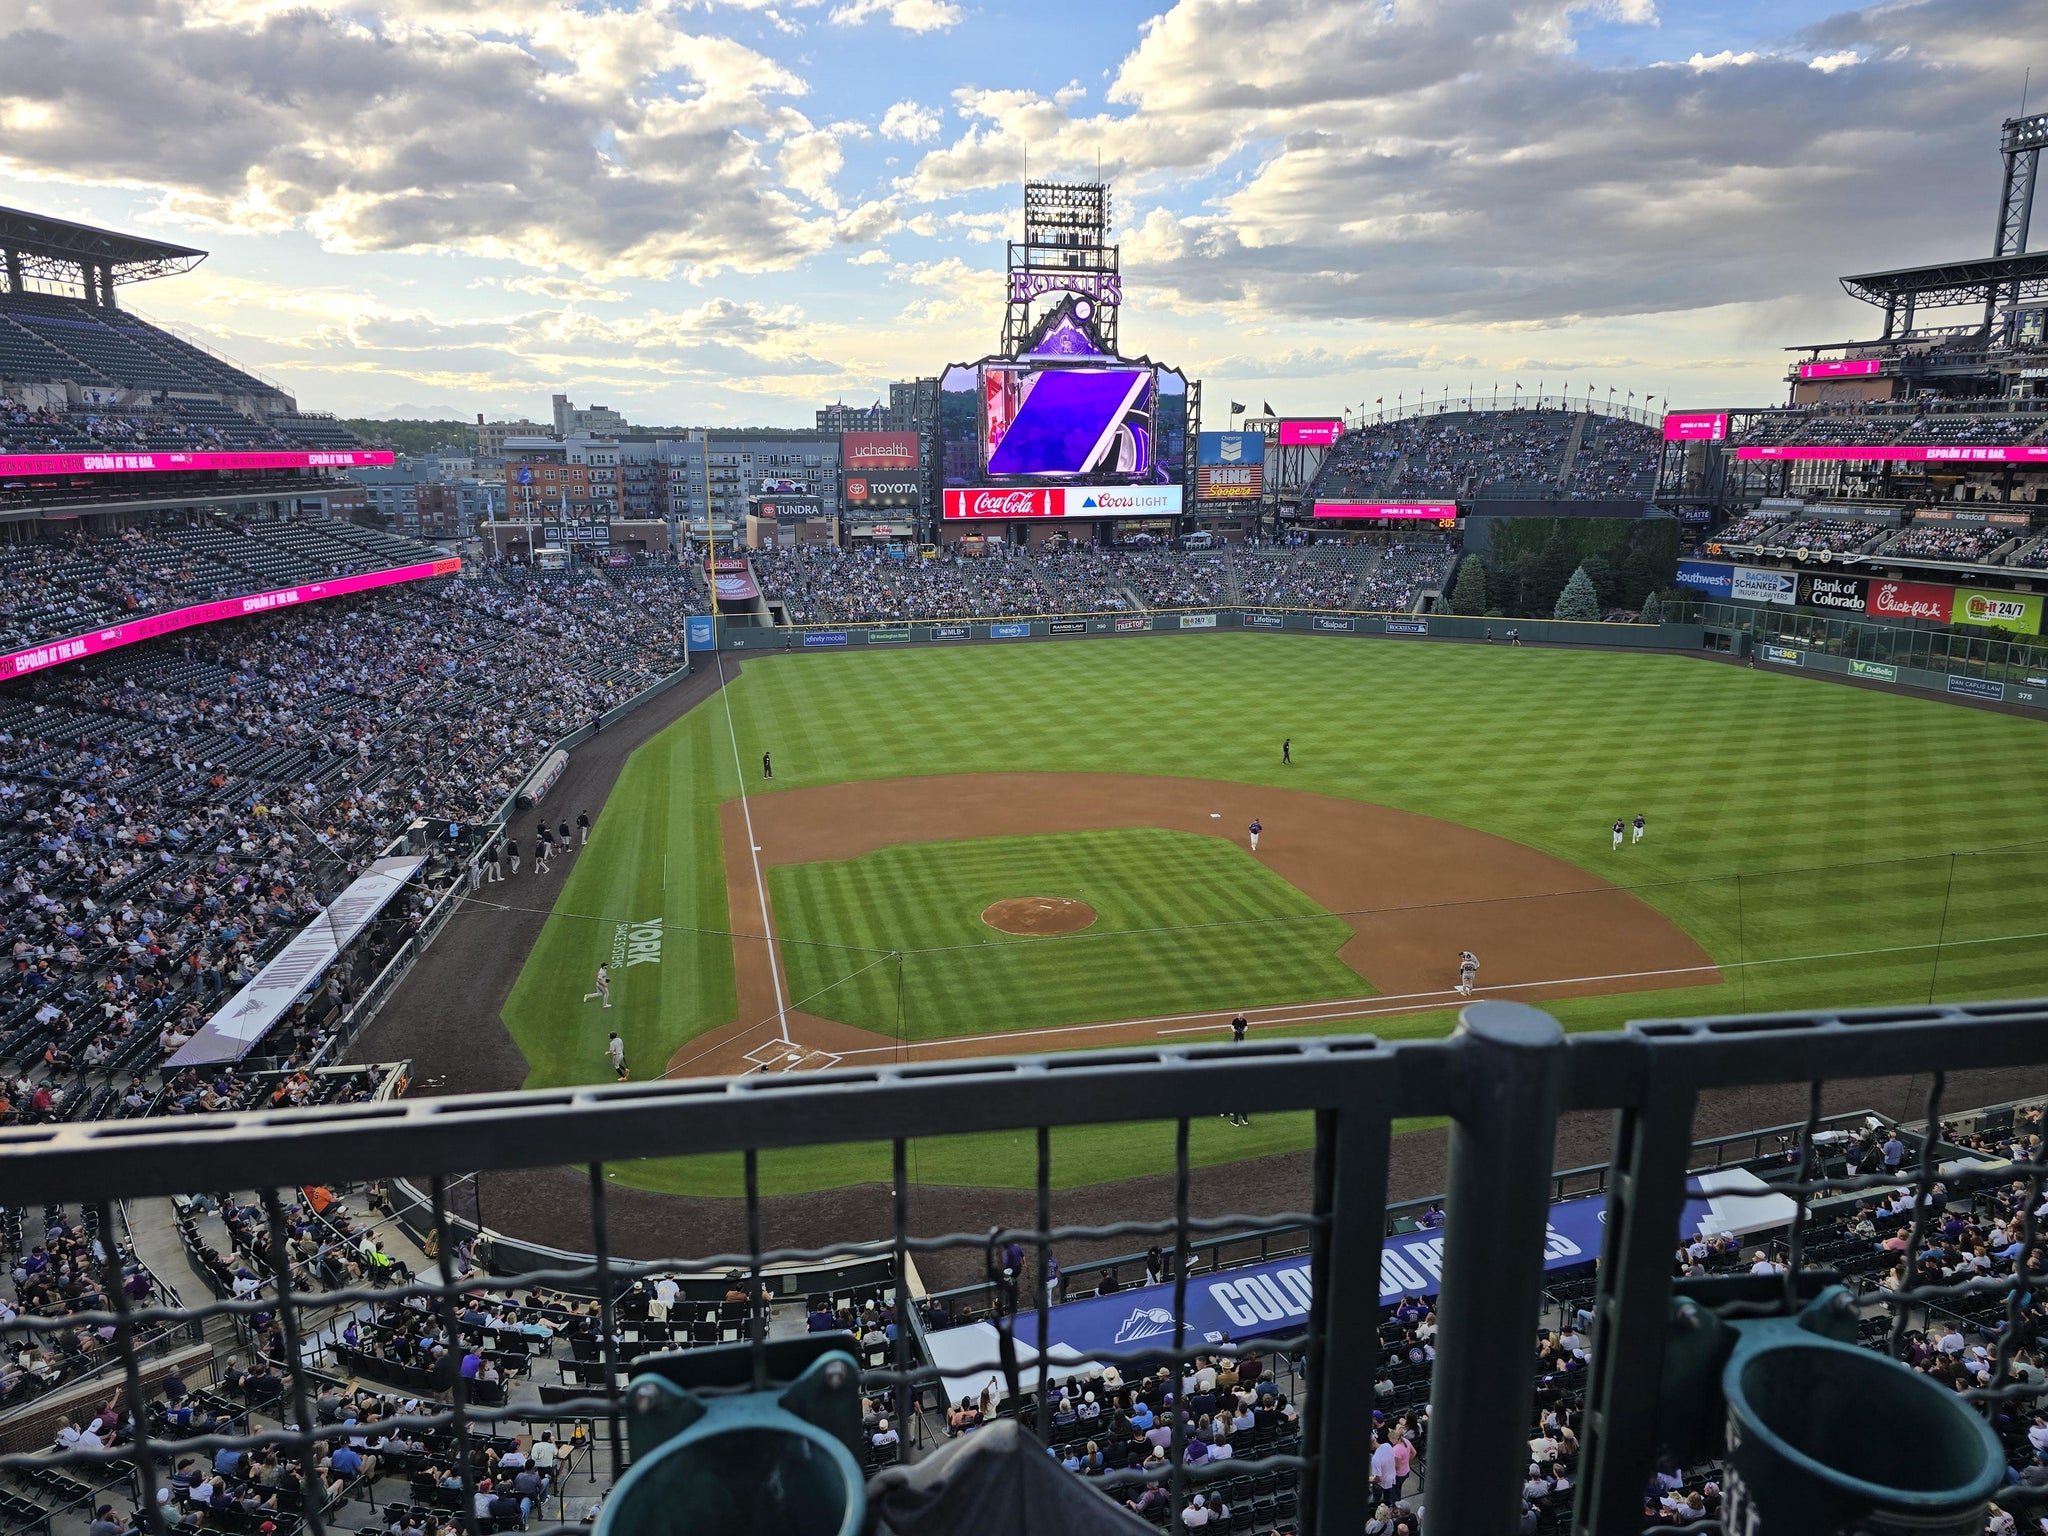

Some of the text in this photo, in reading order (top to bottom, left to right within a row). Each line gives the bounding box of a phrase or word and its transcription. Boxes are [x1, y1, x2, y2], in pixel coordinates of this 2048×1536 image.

[1011, 271, 1122, 305] ROCKIES
[855, 442, 908, 457] uchealth
[1961, 449, 1971, 459] AT
[1972, 449, 1987, 459] THE
[115, 456, 124, 469] AT
[125, 456, 138, 468] THE
[1209, 469, 1251, 484] KING
[871, 484, 918, 494] TOYOTA
[1209, 484, 1251, 497] Soopers
[974, 491, 1035, 514] Coca-Cola
[1098, 493, 1168, 508] Coors LIGHT
[776, 505, 819, 514] TUNDRA
[1808, 506, 1849, 515] FLECHA AZUL
[1869, 508, 1891, 516] birdcall
[1961, 513, 1986, 521] birdcall
[1676, 570, 1724, 586] Southwest
[1745, 572, 1779, 582] BACHUS
[1734, 579, 1778, 592] SCHANKER
[1813, 578, 1858, 594] Bank of
[269, 597, 276, 606] AT
[276, 594, 287, 605] THE
[1738, 589, 1788, 600] INJURY LAWYERS
[1812, 591, 1866, 609] Colorado
[1998, 602, 2024, 617] 24/7
[1253, 616, 1281, 624] Lifetime
[1322, 620, 1348, 629] dialpad
[806, 634, 846, 643] xfinity mobile
[49, 646, 59, 662] AT
[59, 643, 72, 659] THE
[1768, 647, 1798, 660] bet365
[1866, 665, 1893, 677] DaBella
[1950, 678, 1964, 686] DAN
[1964, 681, 1986, 690] CAPLIS
[1986, 684, 2001, 692] LAW
[2017, 692, 2033, 701] 375
[610, 923, 629, 970] SPACE SYSTEMS
[626, 917, 664, 967] YORK
